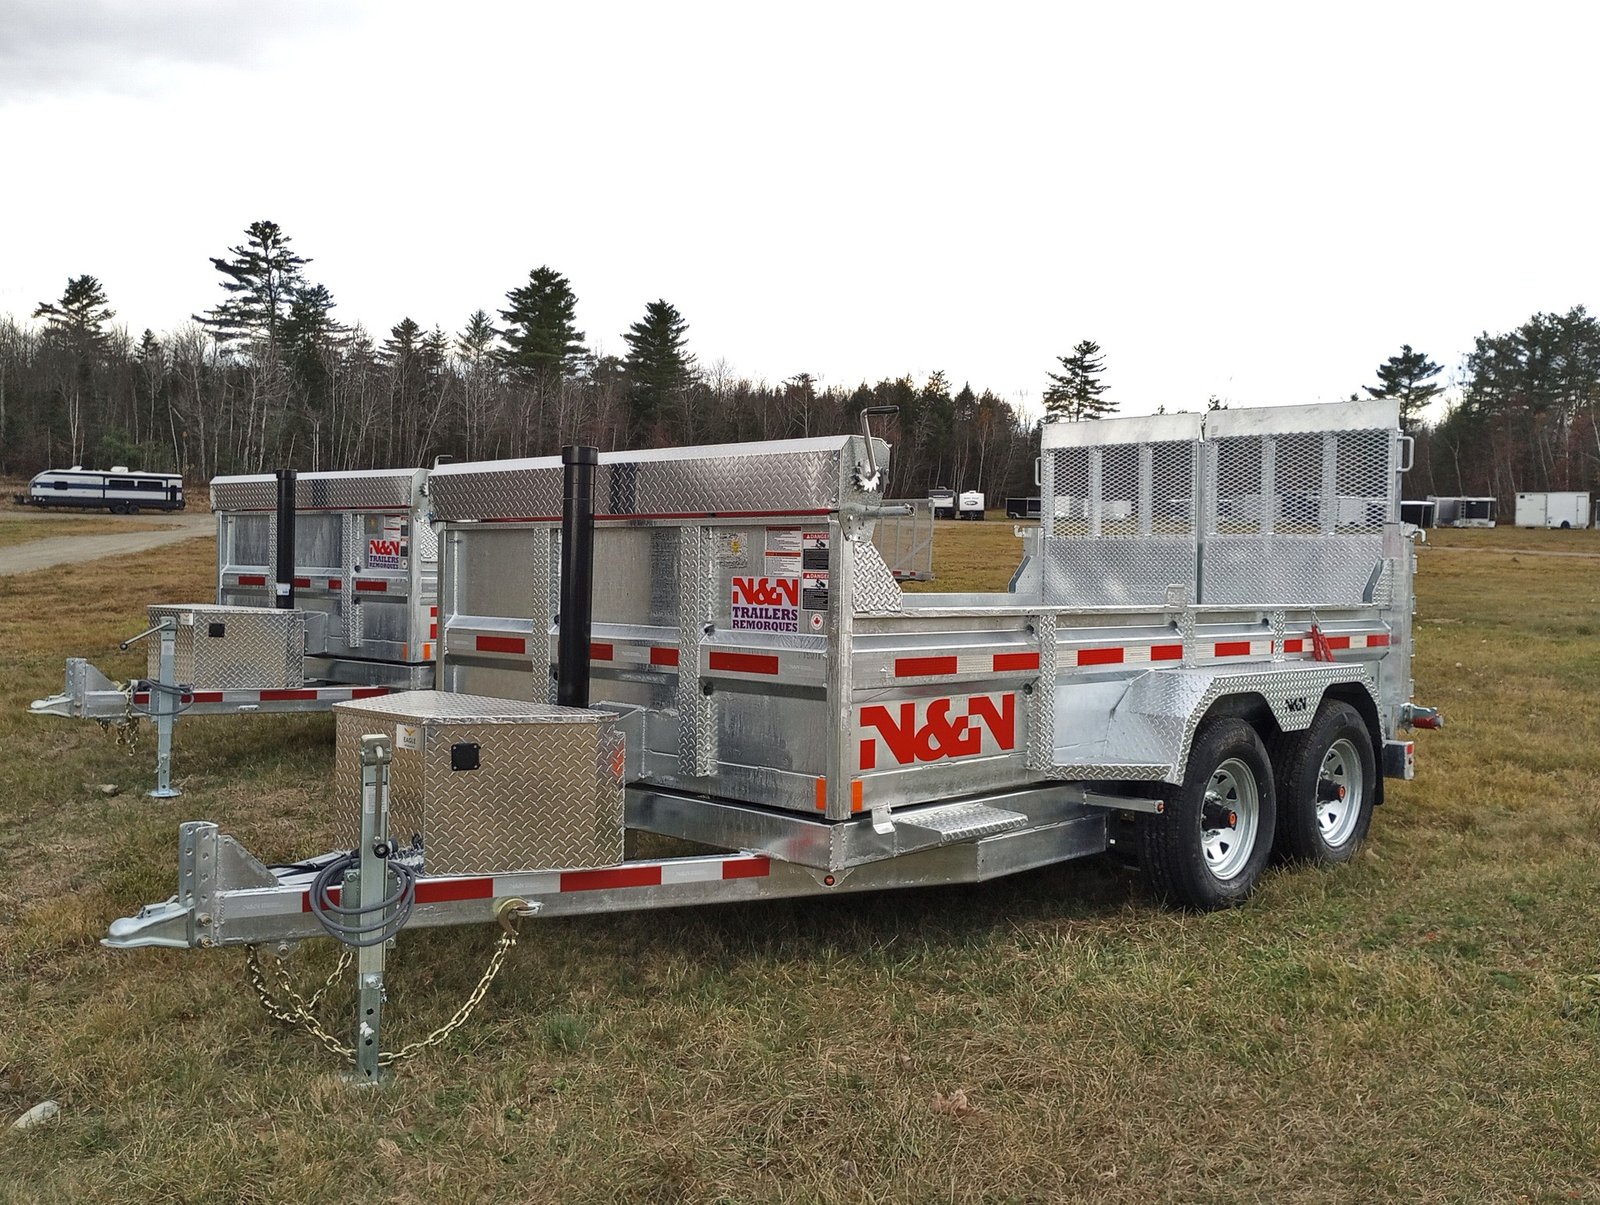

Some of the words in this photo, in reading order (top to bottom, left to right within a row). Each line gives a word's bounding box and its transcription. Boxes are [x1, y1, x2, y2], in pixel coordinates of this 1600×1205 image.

[370, 540, 399, 556] N&N
[369, 562, 399, 570] REMORQUES
[370, 555, 399, 563] TRAILERS
[732, 577, 799, 607] N&N
[732, 606, 798, 621] TRAILERS
[732, 619, 798, 632] REMORQUES
[860, 694, 1015, 770] N&N
[403, 736, 416, 745] EAGLE
